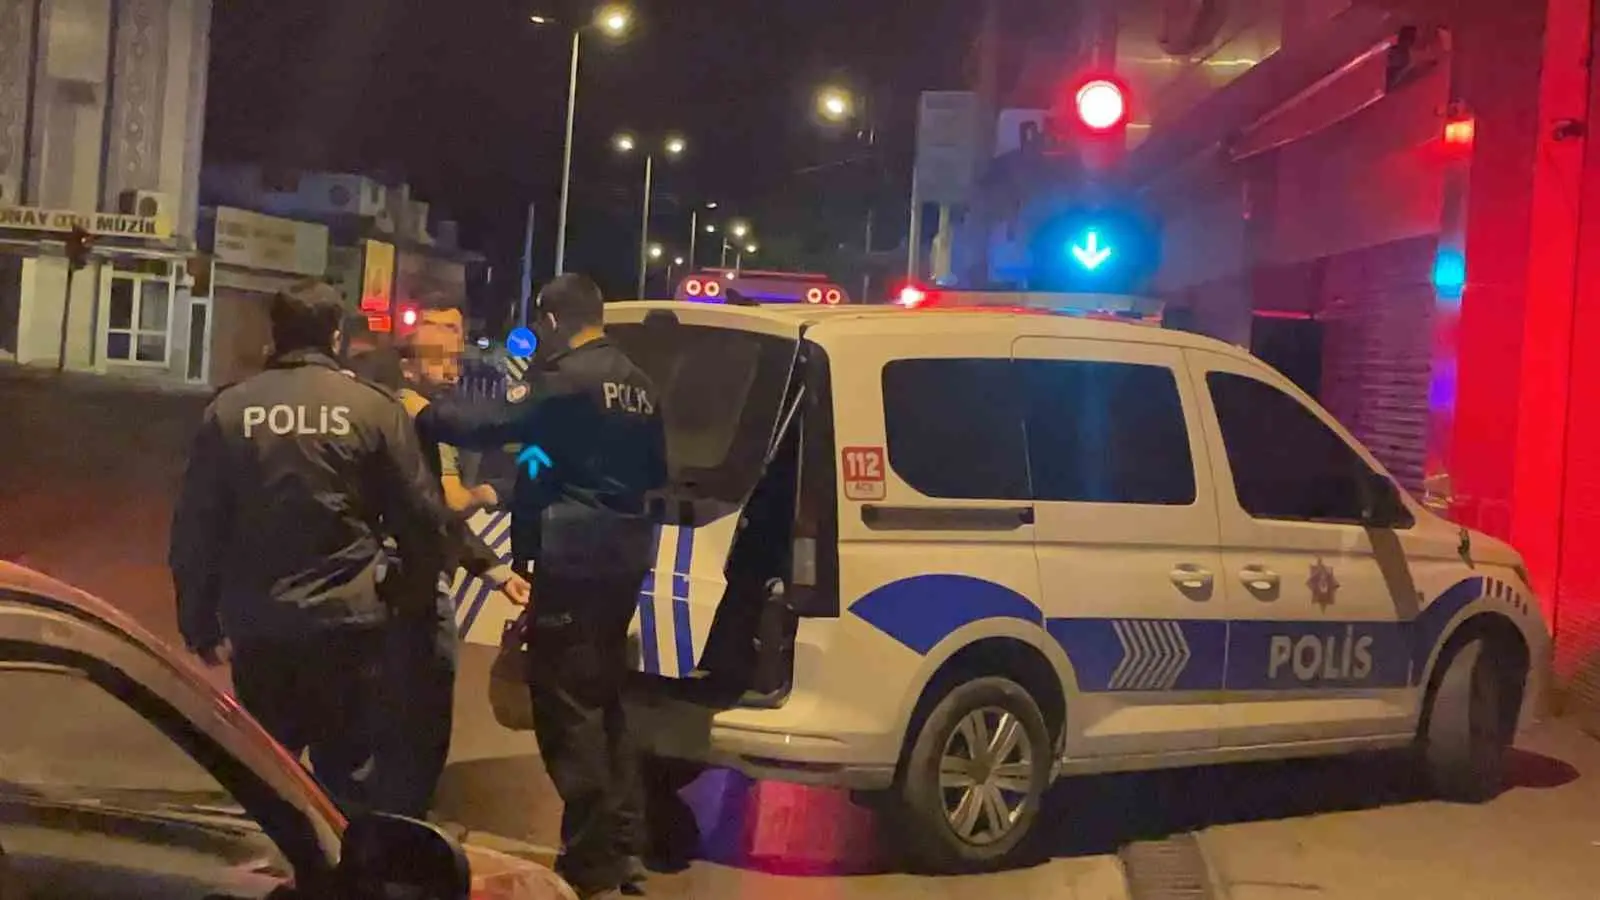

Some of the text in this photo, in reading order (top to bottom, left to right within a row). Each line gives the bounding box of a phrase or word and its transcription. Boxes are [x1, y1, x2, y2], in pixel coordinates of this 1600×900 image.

[244, 404, 351, 438] POLİS
[846, 451, 881, 477] 112
[1268, 624, 1374, 681] POLİS
